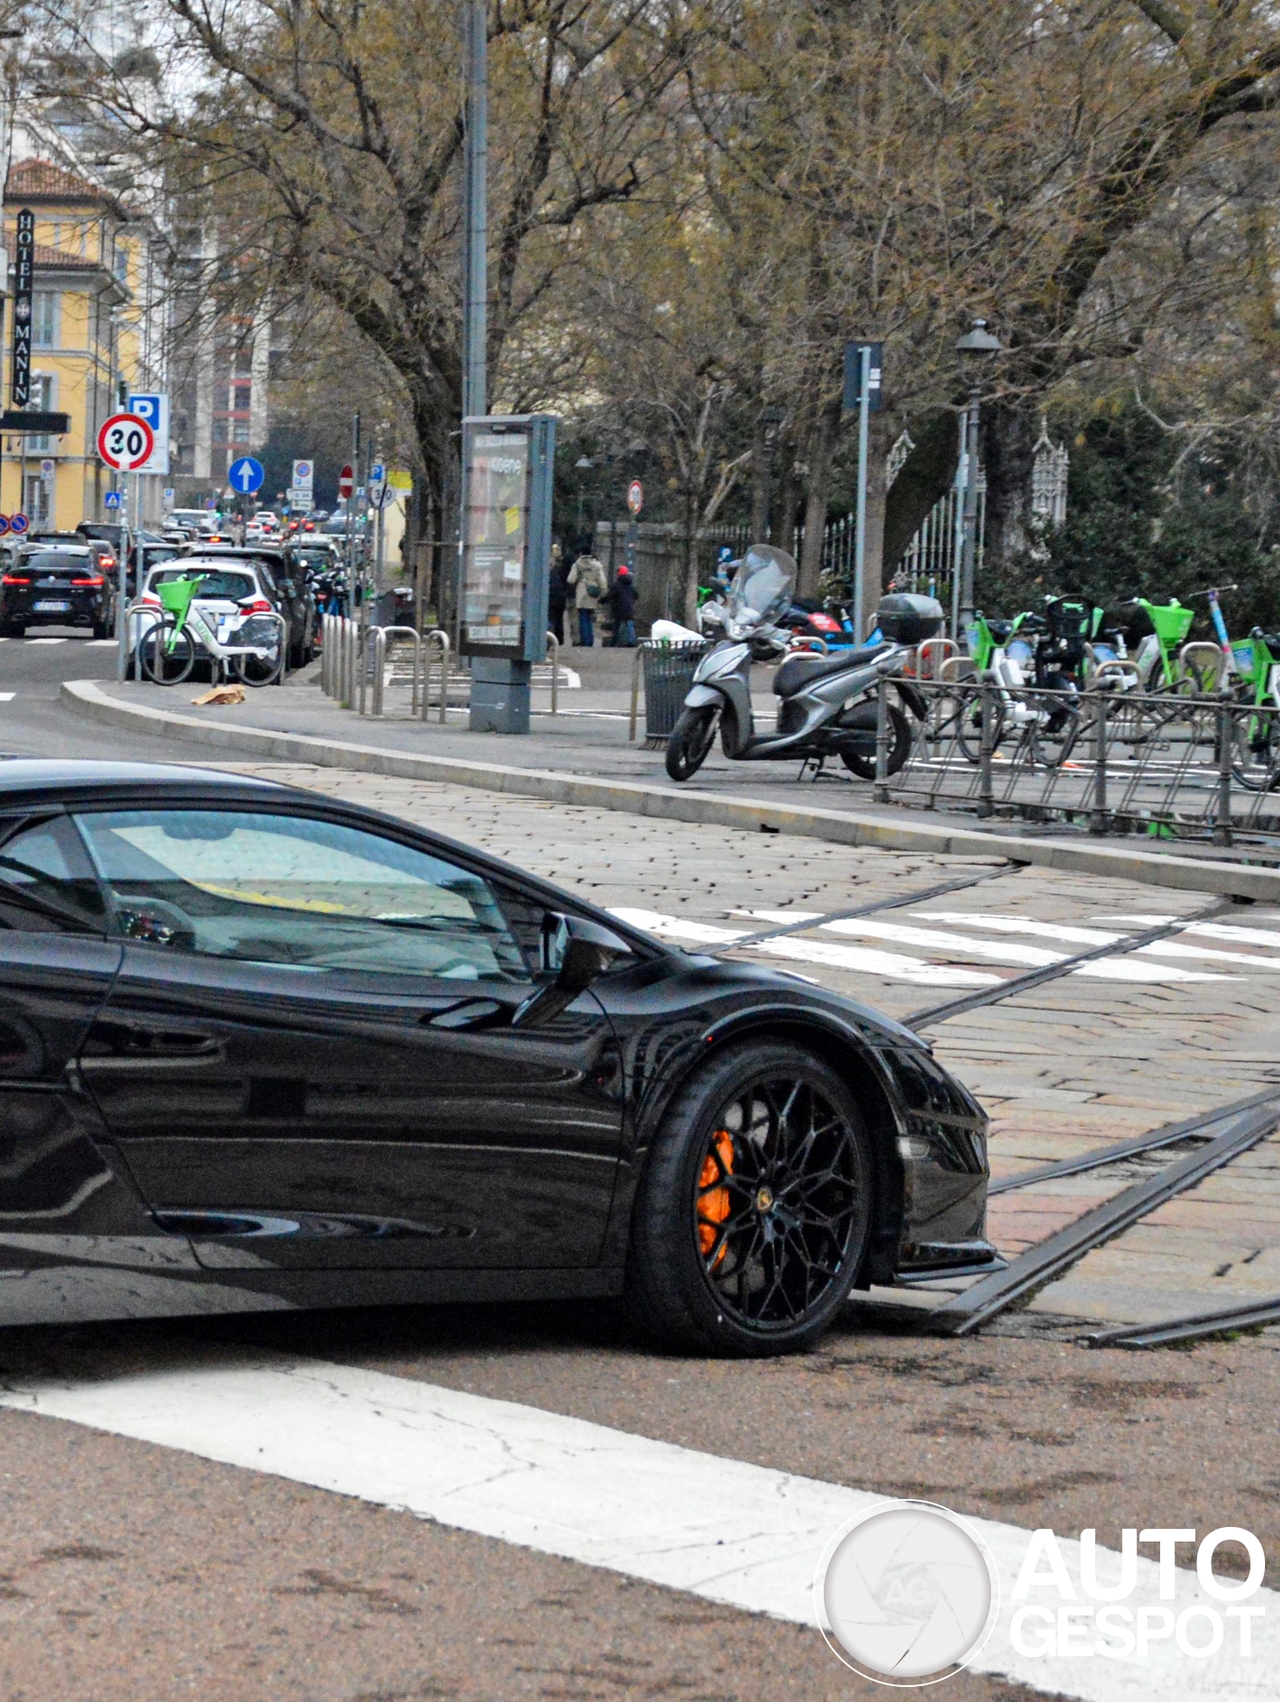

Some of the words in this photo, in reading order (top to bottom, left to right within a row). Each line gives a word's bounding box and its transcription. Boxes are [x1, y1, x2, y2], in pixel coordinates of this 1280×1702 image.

[19, 215, 32, 291] HOTEL
[14, 324, 30, 400] MANIN
[110, 429, 143, 456] 30
